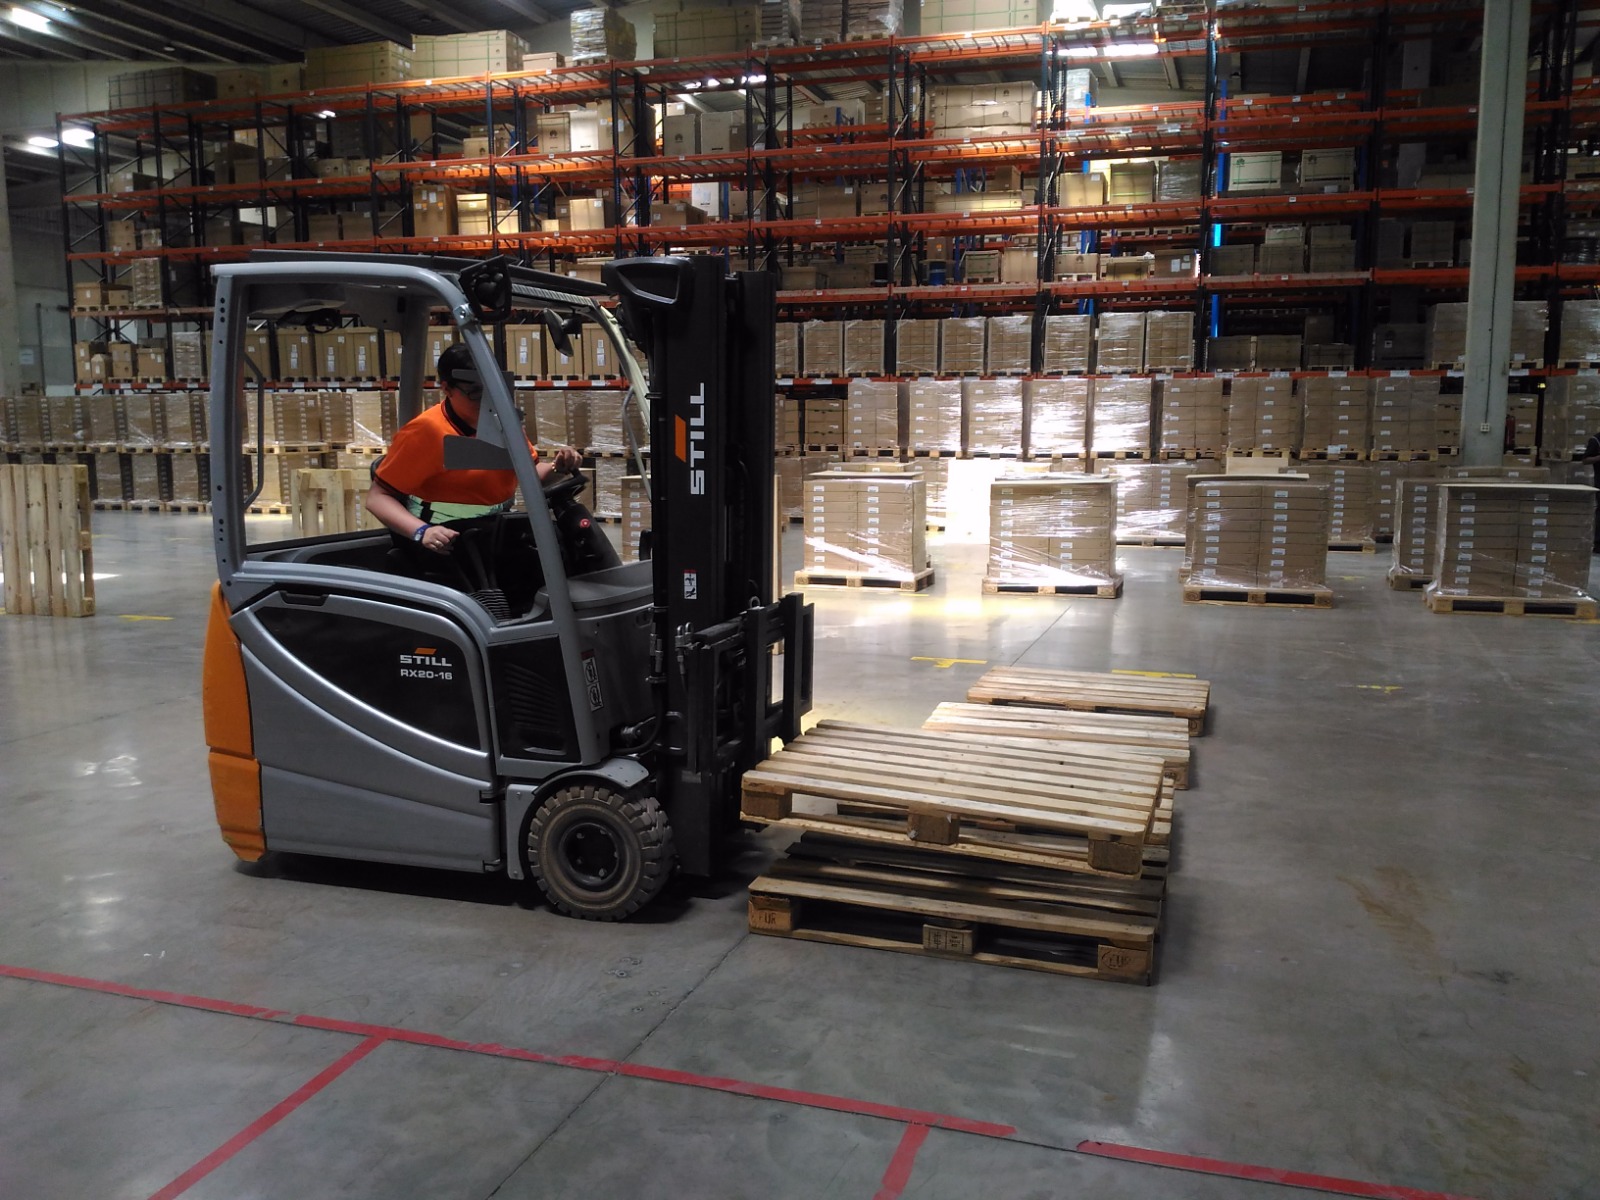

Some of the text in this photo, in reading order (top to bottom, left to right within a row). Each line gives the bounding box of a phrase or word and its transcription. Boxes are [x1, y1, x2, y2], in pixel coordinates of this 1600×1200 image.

[690, 382, 704, 495] STILL
[400, 654, 452, 667] STILL
[400, 668, 453, 680] RX20-16
